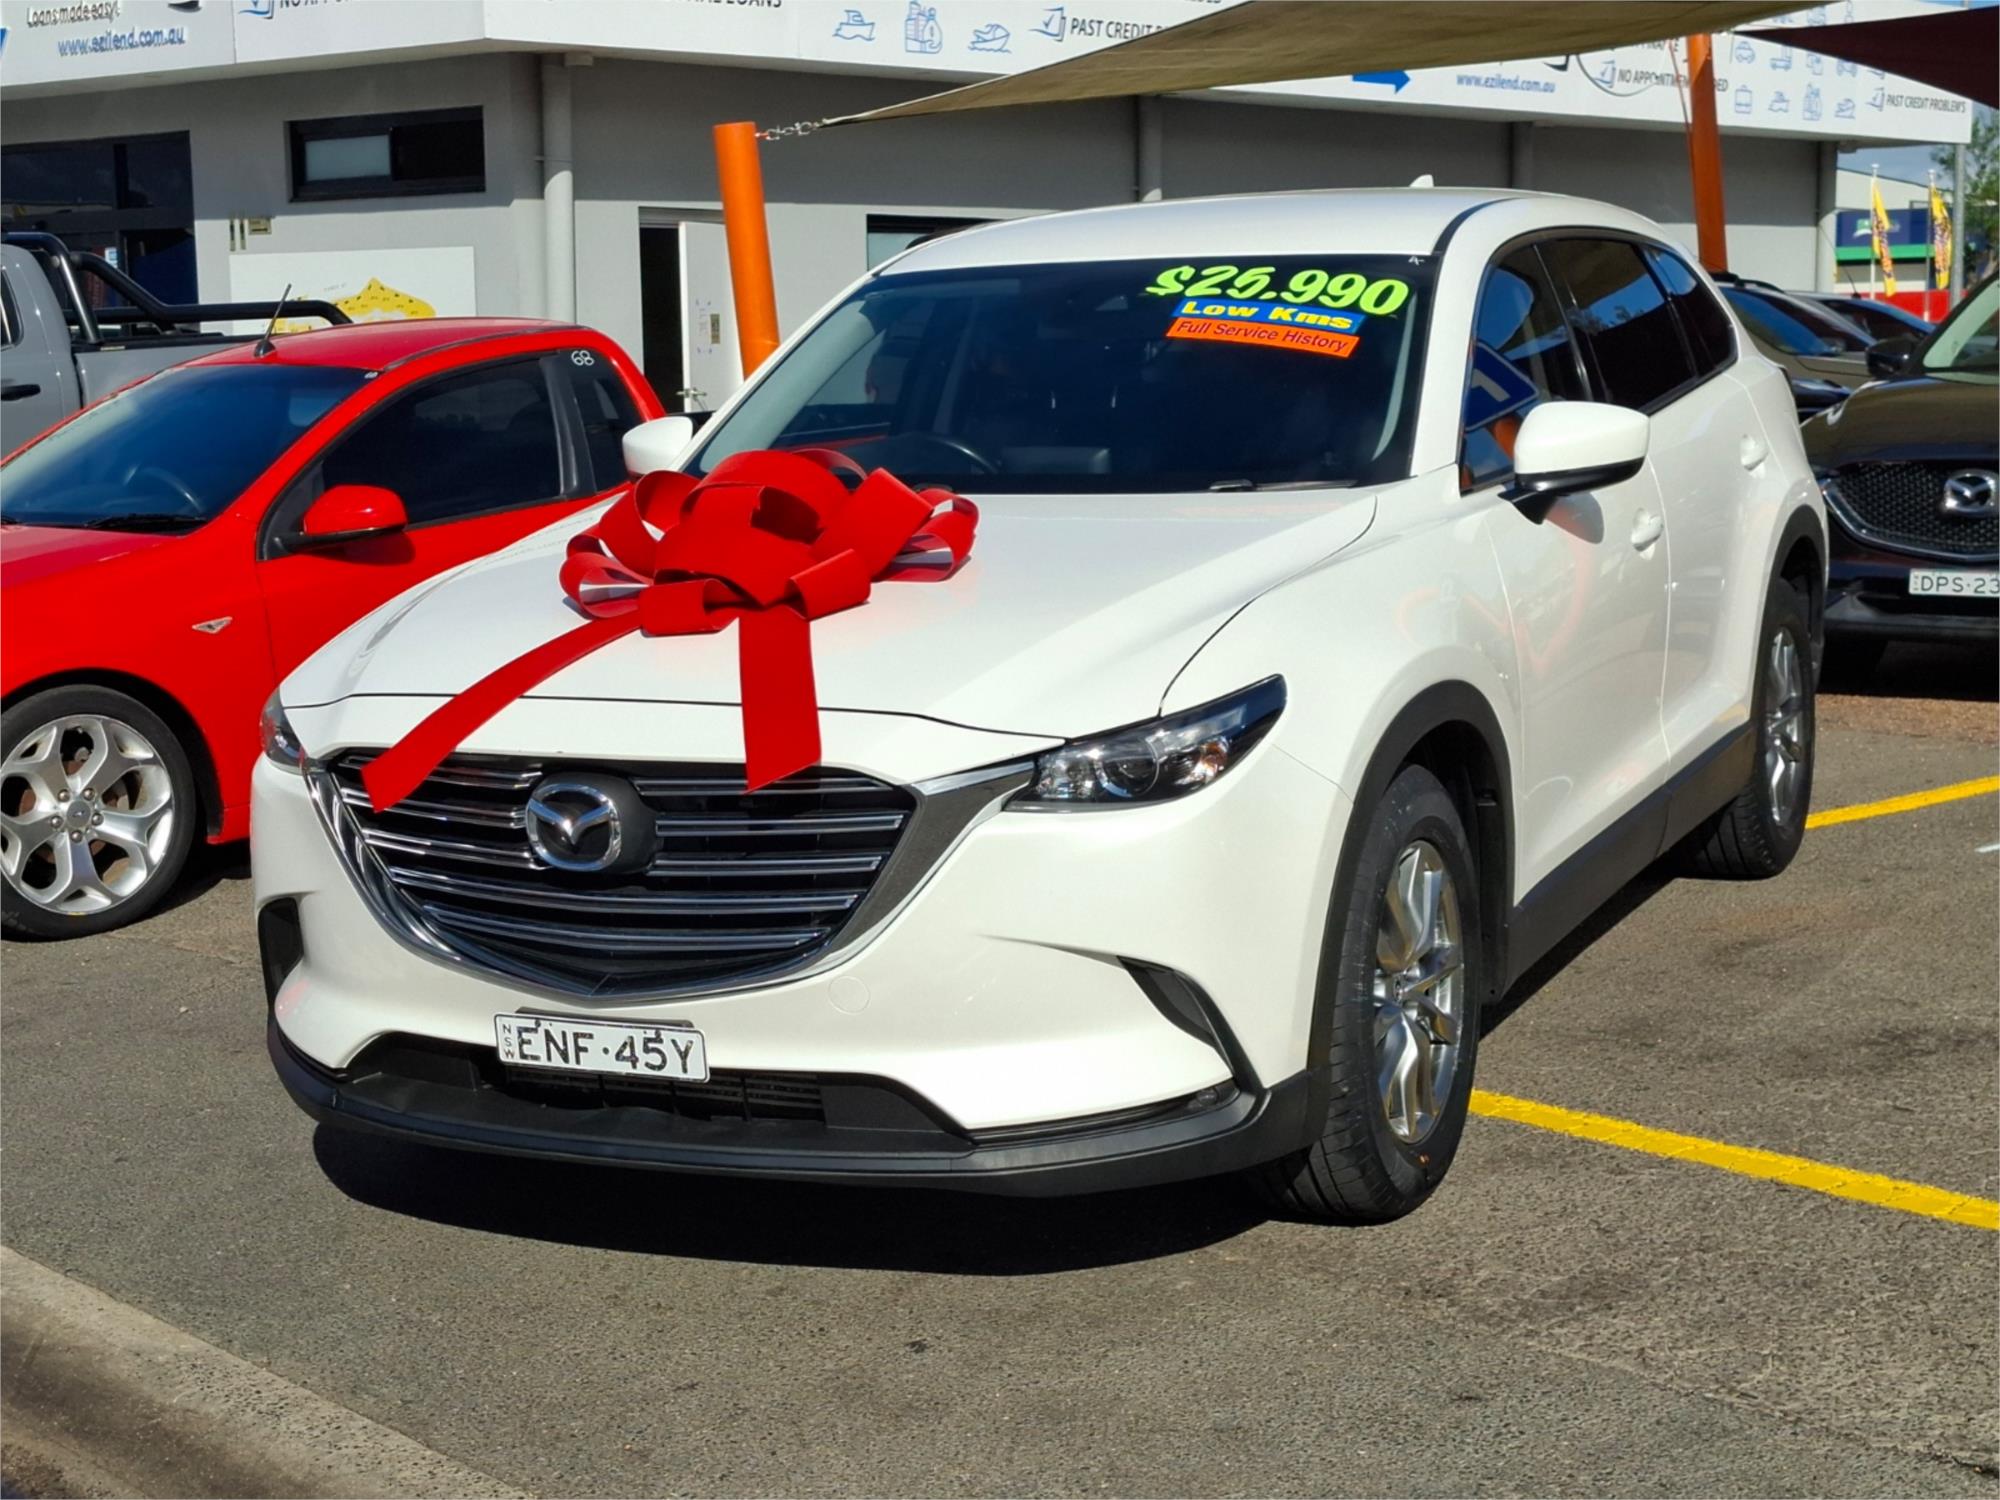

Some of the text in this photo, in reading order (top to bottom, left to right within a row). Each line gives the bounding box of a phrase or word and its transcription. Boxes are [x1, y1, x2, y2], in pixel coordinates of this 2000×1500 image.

[27, 7, 59, 28] Loans
[60, 0, 90, 24] made
[1070, 17, 1152, 40] PAST CREDIT
[57, 27, 186, 56] www.ezilend.com.au
[1456, 73, 1556, 93] www.ezilend.com.au
[1617, 68, 1632, 83] NO
[1886, 94, 1904, 107] PAST
[1904, 95, 1929, 110] CREDIT
[1181, 301, 1353, 330] Low Kms
[1177, 321, 1347, 353] Full Service History
[571, 350, 595, 366] 68
